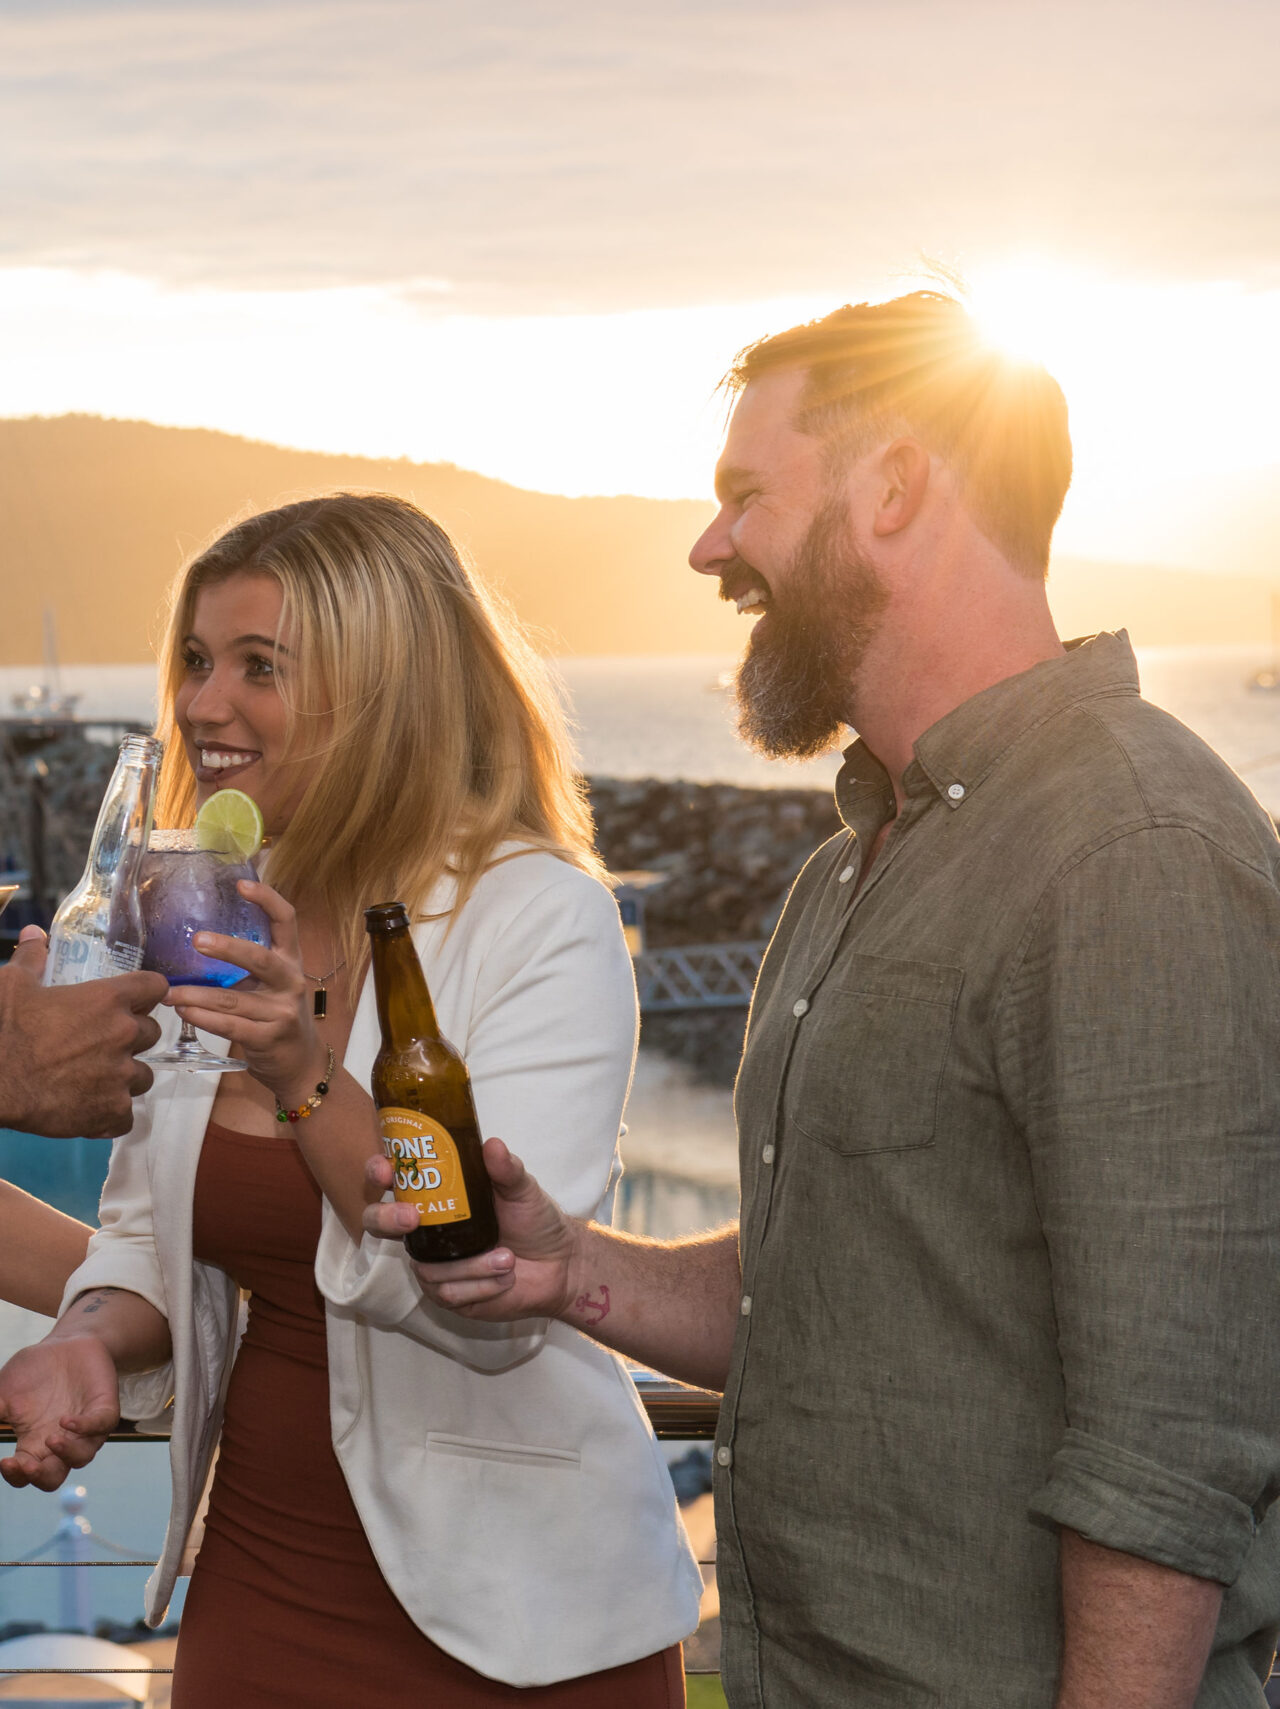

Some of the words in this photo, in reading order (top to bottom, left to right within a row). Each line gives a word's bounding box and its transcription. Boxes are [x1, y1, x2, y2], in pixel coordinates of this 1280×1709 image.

[385, 1116, 423, 1130] ORIGINAL
[383, 1135, 437, 1159] TONE
[393, 1167, 442, 1191] OOD
[427, 1198, 456, 1213] ALE
